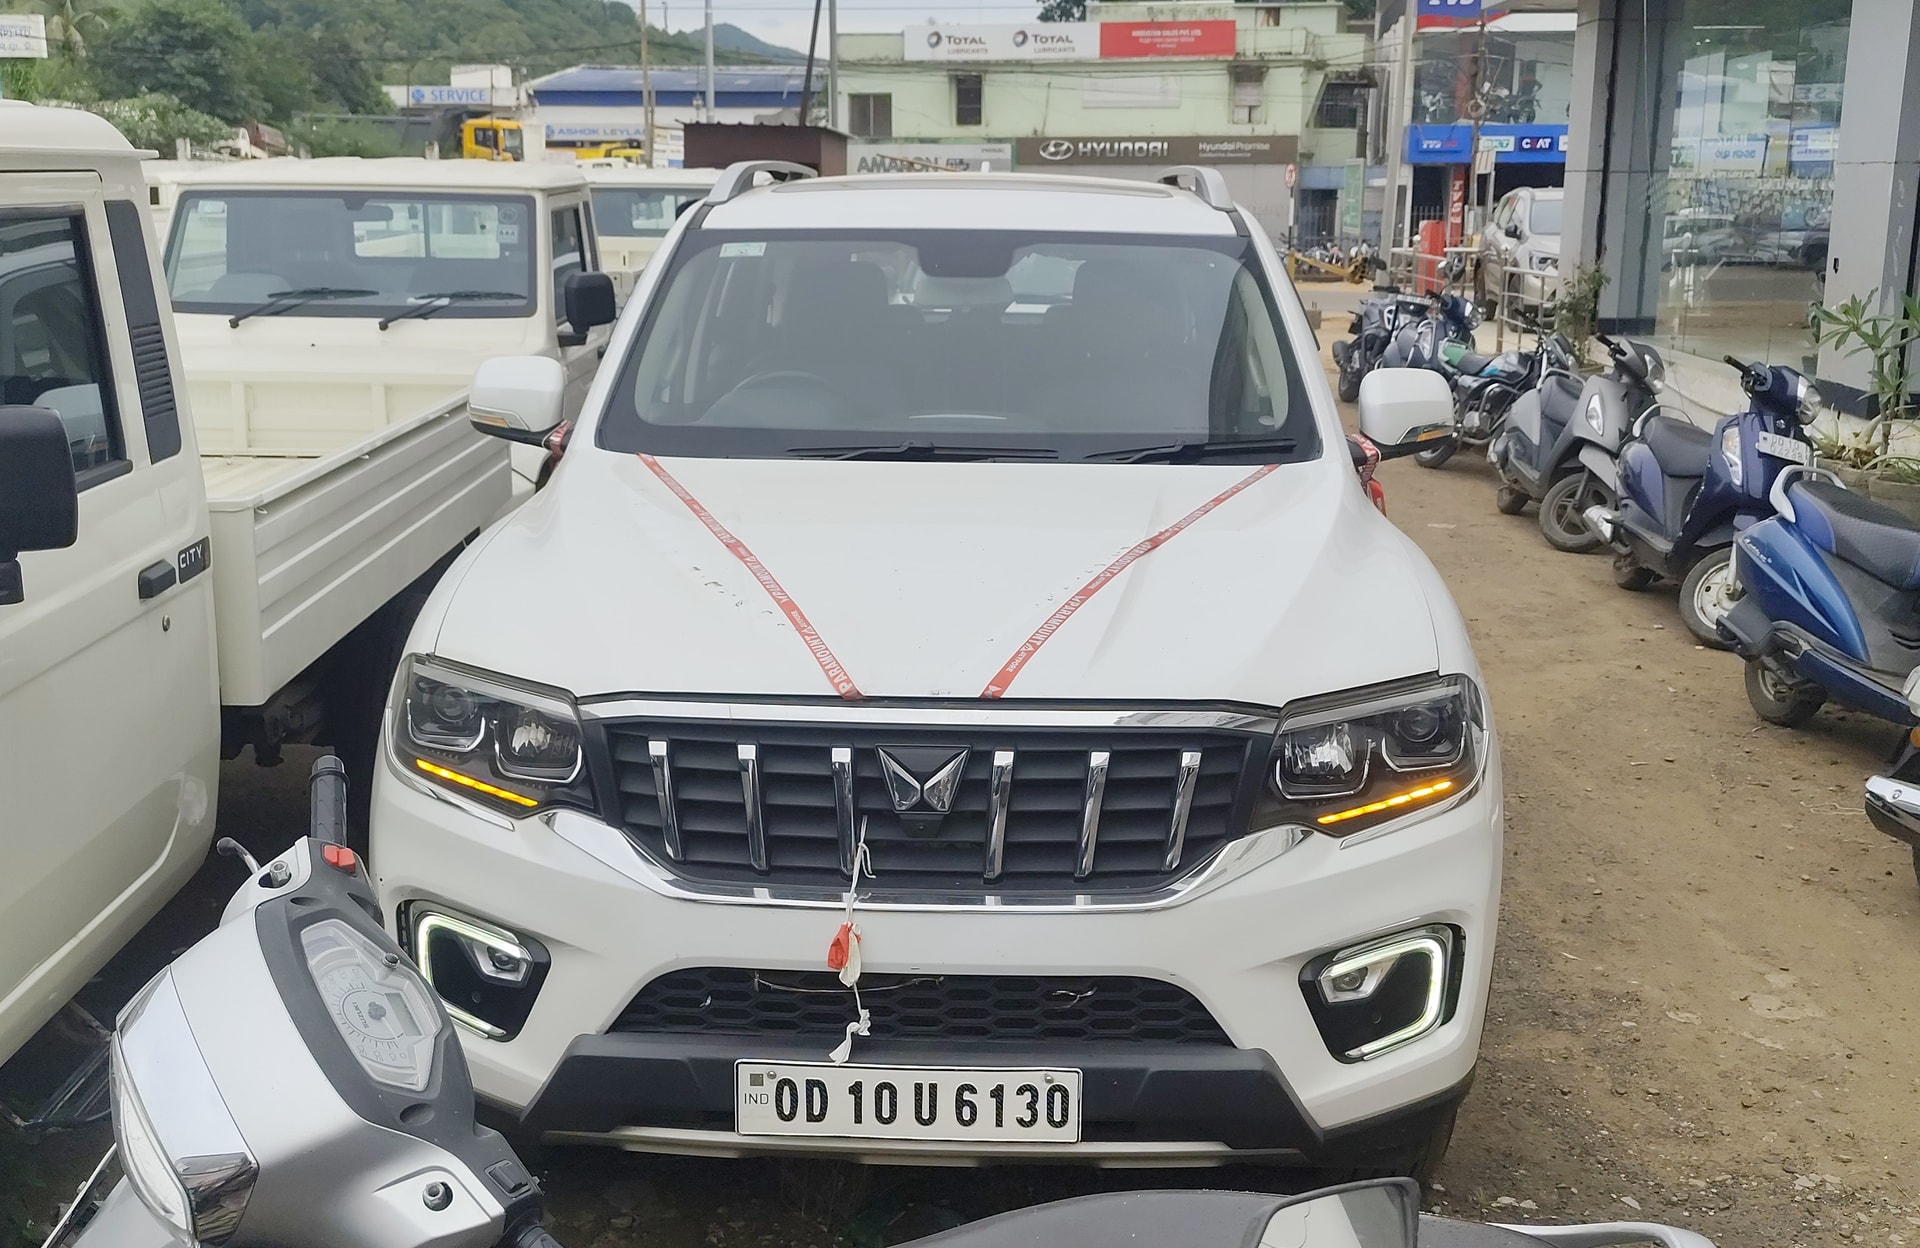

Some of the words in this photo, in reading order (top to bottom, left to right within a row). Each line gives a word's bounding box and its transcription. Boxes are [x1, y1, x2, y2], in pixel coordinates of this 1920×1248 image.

[945, 35, 987, 45] TOTAL
[1032, 34, 1073, 44] TOTAL
[431, 89, 486, 101] SERVICE
[558, 128, 599, 136] ASHOK
[603, 128, 653, 136] LEYLA
[1078, 142, 1168, 157] HYUNDAI
[1198, 142, 1235, 152] Hyundai
[1422, 139, 1441, 149] TVS
[1521, 138, 1552, 149] CEAT
[180, 544, 202, 569] CITY
[1027, 601, 1079, 646] PARAMOUNT
[805, 633, 852, 694] PARAMOUNT
[352, 1001, 369, 1029] SUZUKI
[743, 1093, 769, 1105] IND
[848, 1080, 898, 1126] 10
[914, 1082, 938, 1127] U
[954, 1083, 1070, 1129] 6130
